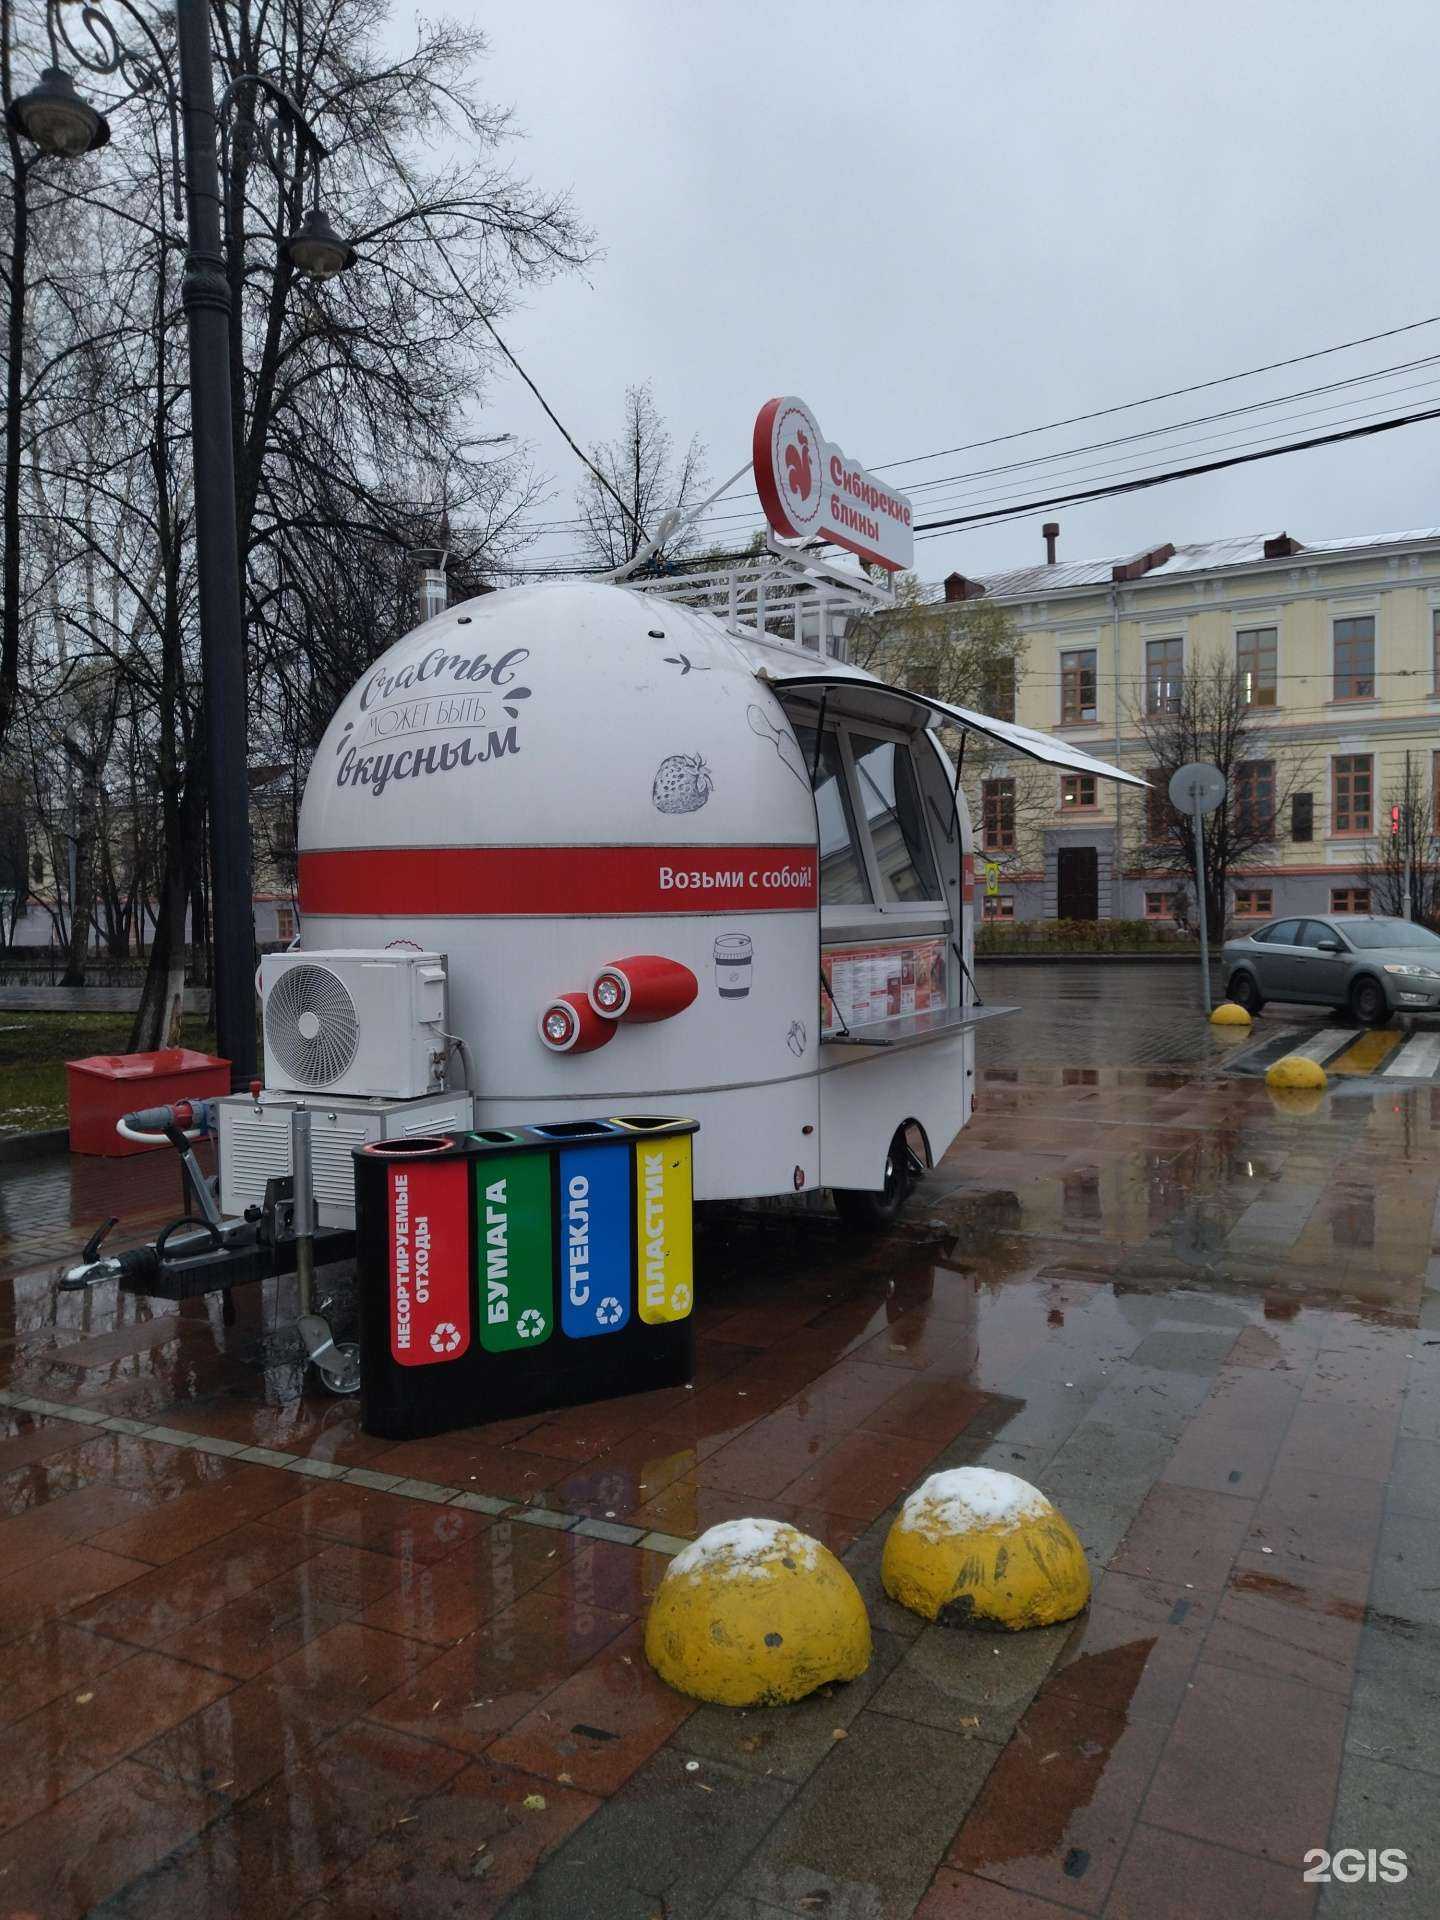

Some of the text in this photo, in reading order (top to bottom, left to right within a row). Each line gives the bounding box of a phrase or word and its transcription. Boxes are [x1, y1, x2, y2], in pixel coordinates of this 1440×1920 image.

[830, 455, 911, 527] Сибирские
[830, 493, 880, 542] блины
[436, 697, 486, 725] БЫТЬ
[659, 866, 812, 890] Возьми с собой!
[395, 1174, 411, 1349] НЕСОРТИРУЕМЫЕ
[415, 1216, 431, 1304] ОТХОДЫ
[486, 1178, 509, 1325] БУМАГА
[568, 1175, 590, 1307] СТЕКЛО
[645, 1152, 665, 1306] ПЛАСТИК
